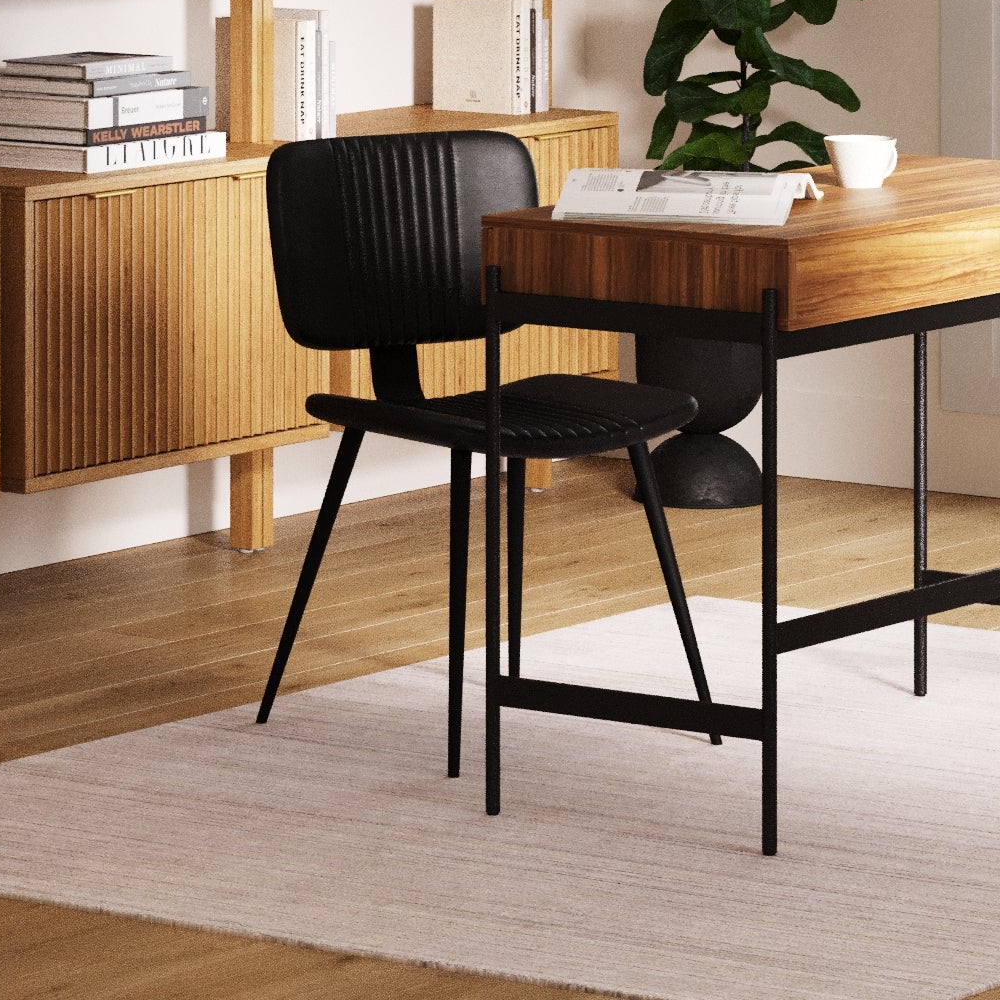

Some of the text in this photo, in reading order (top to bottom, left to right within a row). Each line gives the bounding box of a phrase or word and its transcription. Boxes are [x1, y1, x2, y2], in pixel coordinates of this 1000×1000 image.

[105, 61, 146, 76] MINIMAL
[154, 77, 177, 88] Nature
[93, 120, 200, 143] KELLY WEARSTLER
